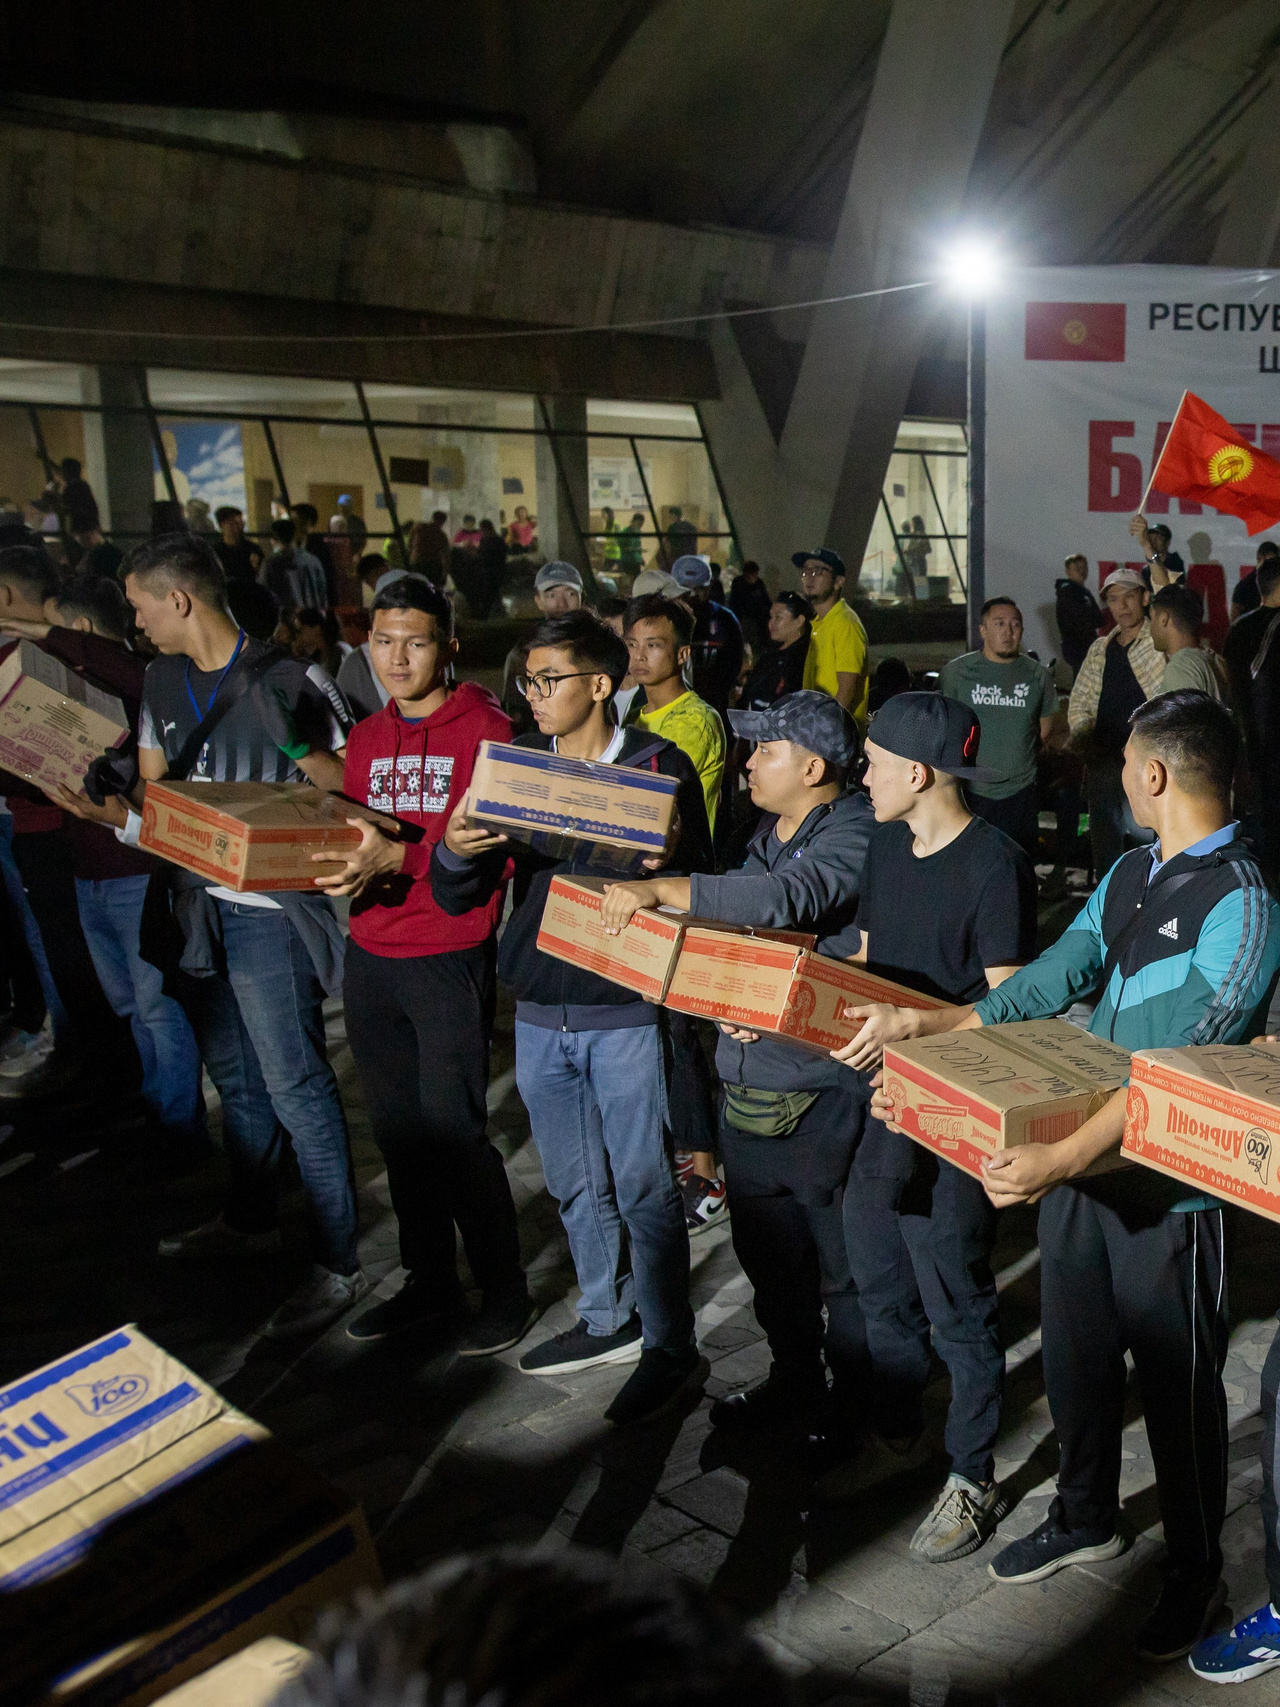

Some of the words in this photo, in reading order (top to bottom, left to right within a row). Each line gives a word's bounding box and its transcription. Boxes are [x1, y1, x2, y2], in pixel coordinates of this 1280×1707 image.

[971, 683, 1002, 696] Jack
[322, 680, 349, 723] PUMA
[971, 694, 1026, 707] Wolfskin
[1158, 927, 1178, 940] adidas
[922, 1040, 1025, 1086] КУКСИ
[1133, 1068, 1143, 1078] LTD
[1144, 1072, 1169, 1089] COMPANY
[1170, 1082, 1213, 1105] INTERNATIONAL
[1166, 1102, 1245, 1159] АЛЬКОНИ
[1247, 1138, 1269, 1160] 100
[1157, 1151, 1190, 1170] ВКУСОМ!
[1195, 1168, 1205, 1178] СО
[1211, 1174, 1246, 1196] СДЕЛАНО
[91, 1379, 138, 1412] 100
